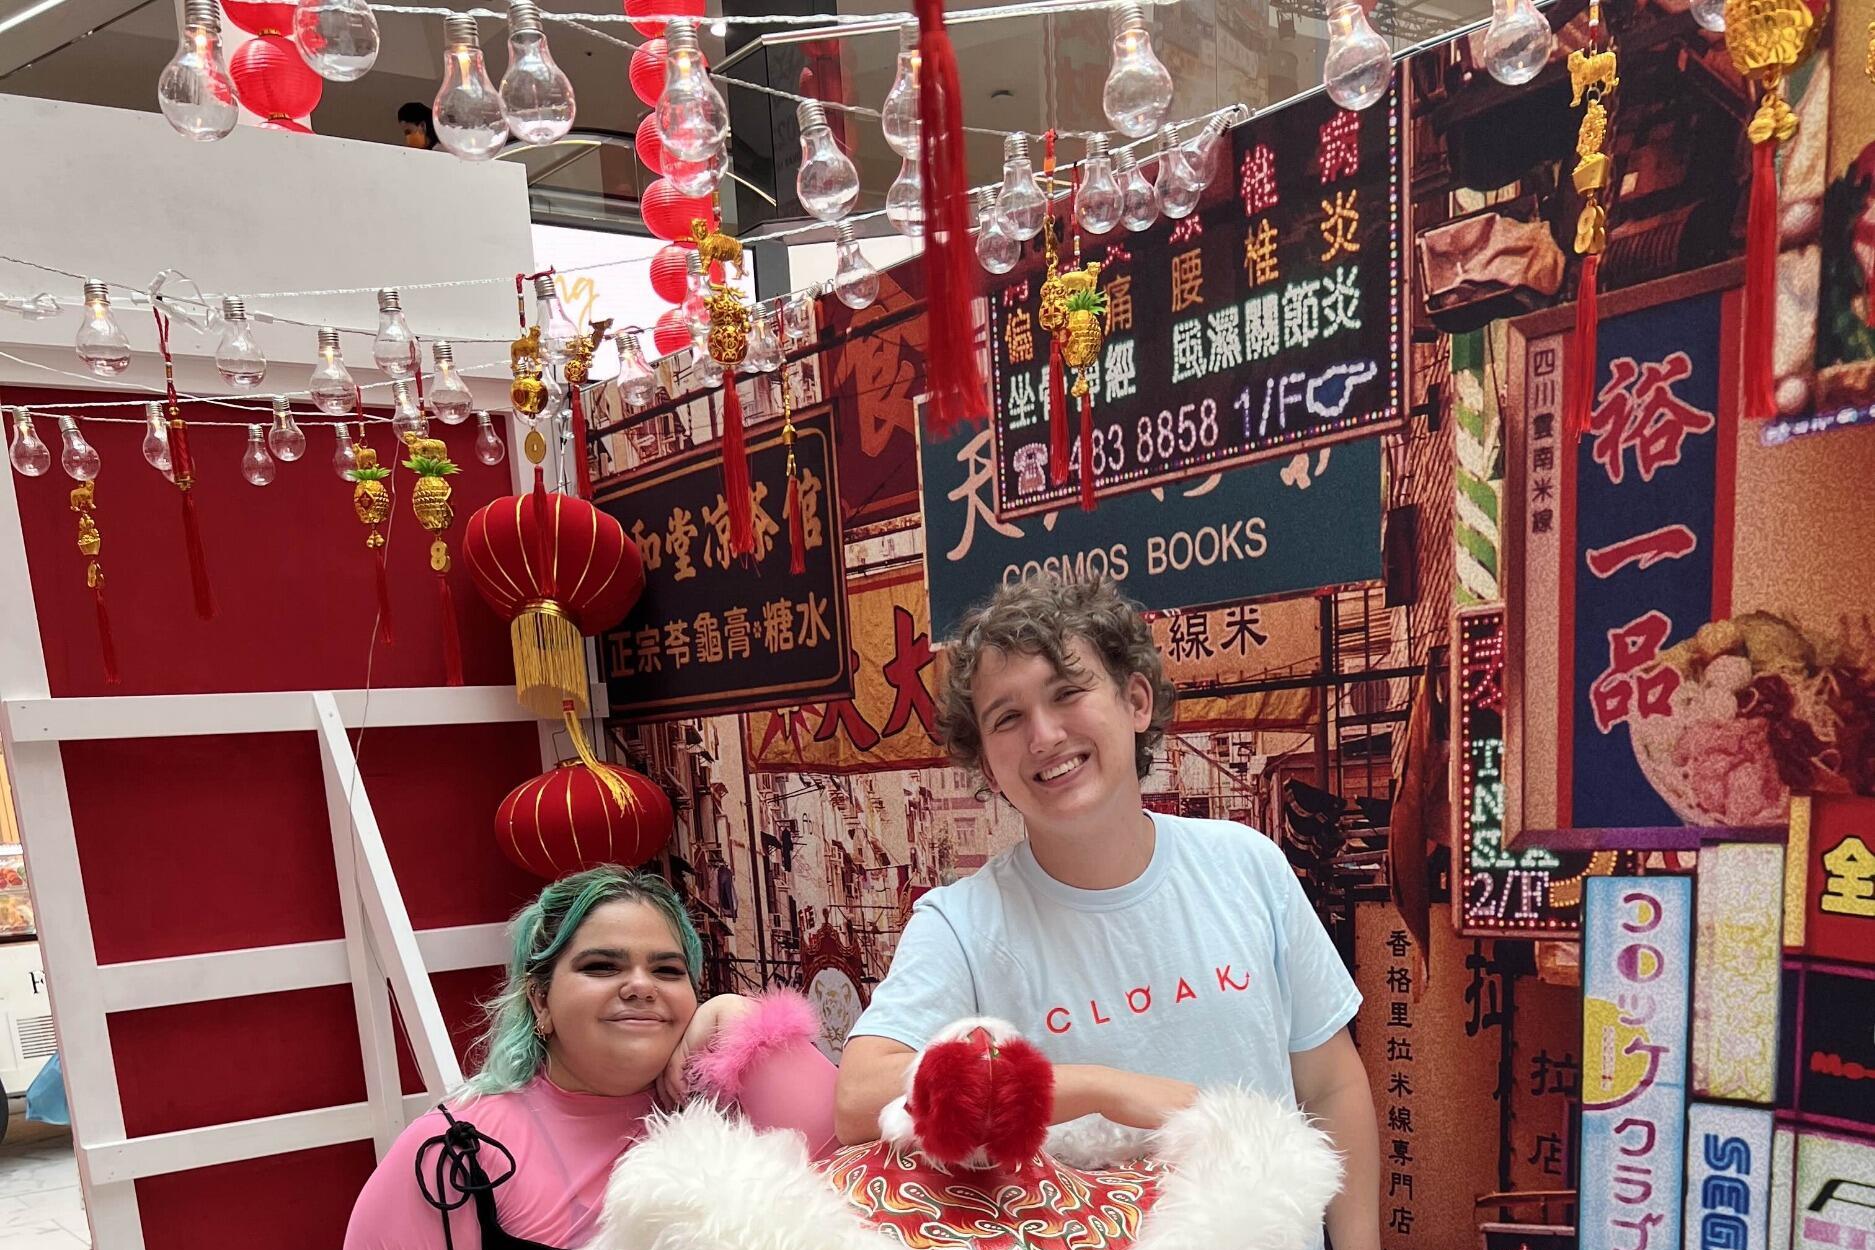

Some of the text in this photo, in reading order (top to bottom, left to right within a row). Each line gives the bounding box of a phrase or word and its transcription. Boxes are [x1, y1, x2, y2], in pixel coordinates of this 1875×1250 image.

[1137, 398, 1219, 463] 8858
[1002, 516, 1268, 590] COSMOS BOOKS
[1586, 350, 1715, 735] 裕一品
[1469, 870, 1549, 918] 2/F
[1046, 964, 1250, 1034] CLOAK
[1386, 930, 1414, 1235] 香格里拉米線專門店
